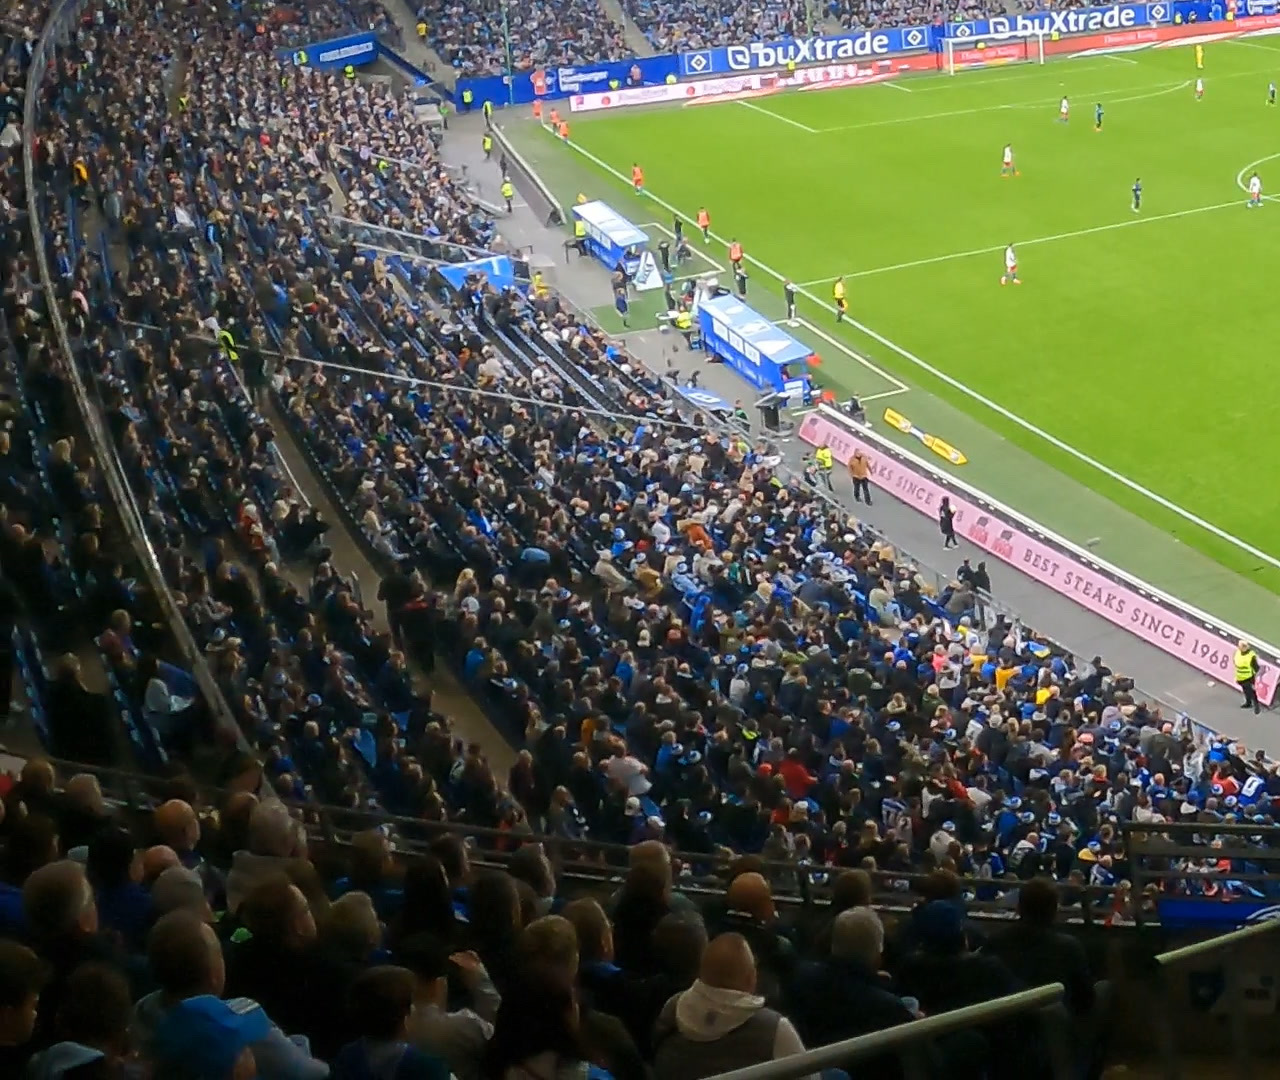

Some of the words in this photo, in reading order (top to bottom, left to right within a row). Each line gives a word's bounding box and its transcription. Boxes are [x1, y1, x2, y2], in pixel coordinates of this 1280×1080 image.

[1016, 6, 1135, 34] buXtrade
[756, 32, 889, 68] buXtrade
[824, 432, 848, 455] BEST
[895, 475, 935, 505] SINCE
[1023, 548, 1060, 577] BEST
[1063, 571, 1126, 614] STEAKS
[1130, 607, 1186, 646] SINCE
[1191, 638, 1230, 670] 1968
